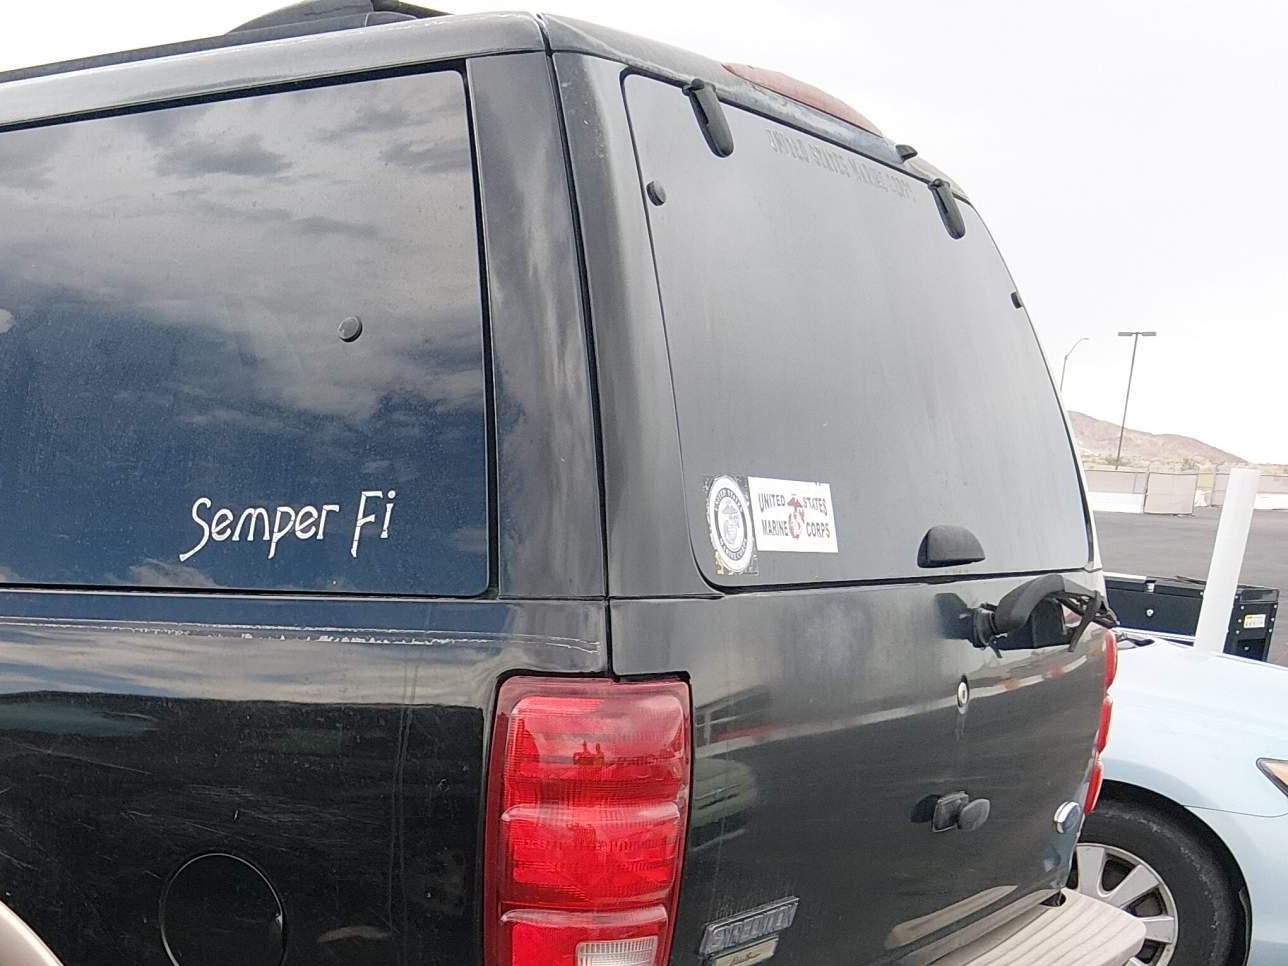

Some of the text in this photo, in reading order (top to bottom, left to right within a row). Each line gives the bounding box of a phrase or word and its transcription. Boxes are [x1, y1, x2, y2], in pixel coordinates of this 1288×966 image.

[758, 493, 827, 516] UNITED STATES
[179, 490, 396, 562] Semper Fi
[762, 519, 830, 538] MARINE CORPS
